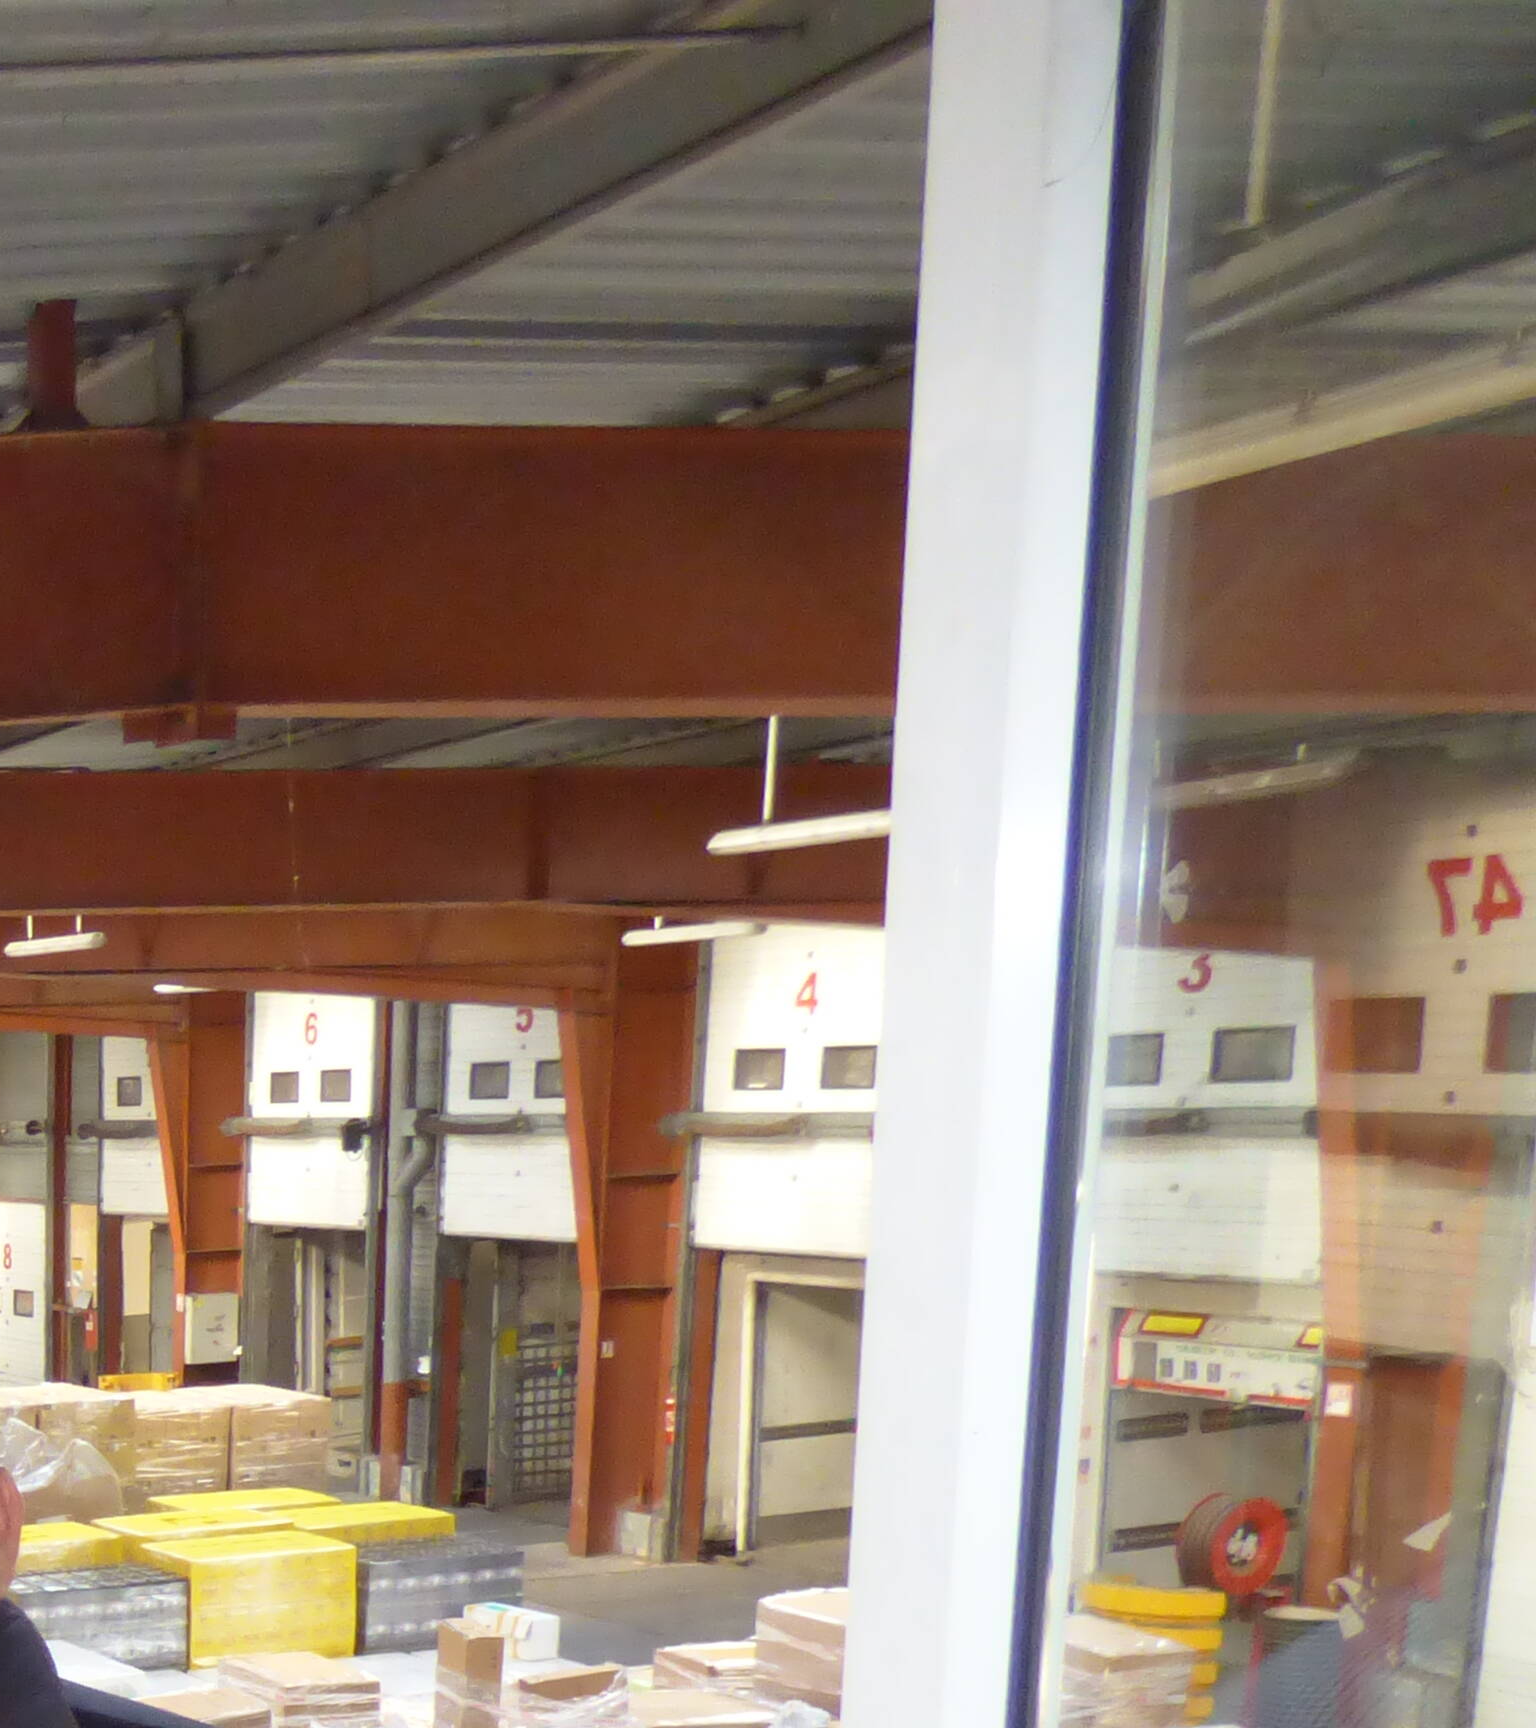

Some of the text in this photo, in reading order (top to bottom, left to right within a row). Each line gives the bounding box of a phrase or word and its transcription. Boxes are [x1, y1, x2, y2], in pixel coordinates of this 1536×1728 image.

[794, 972, 819, 1014] 4
[304, 1012, 318, 1046] 6
[3, 1243, 13, 1270] 8
